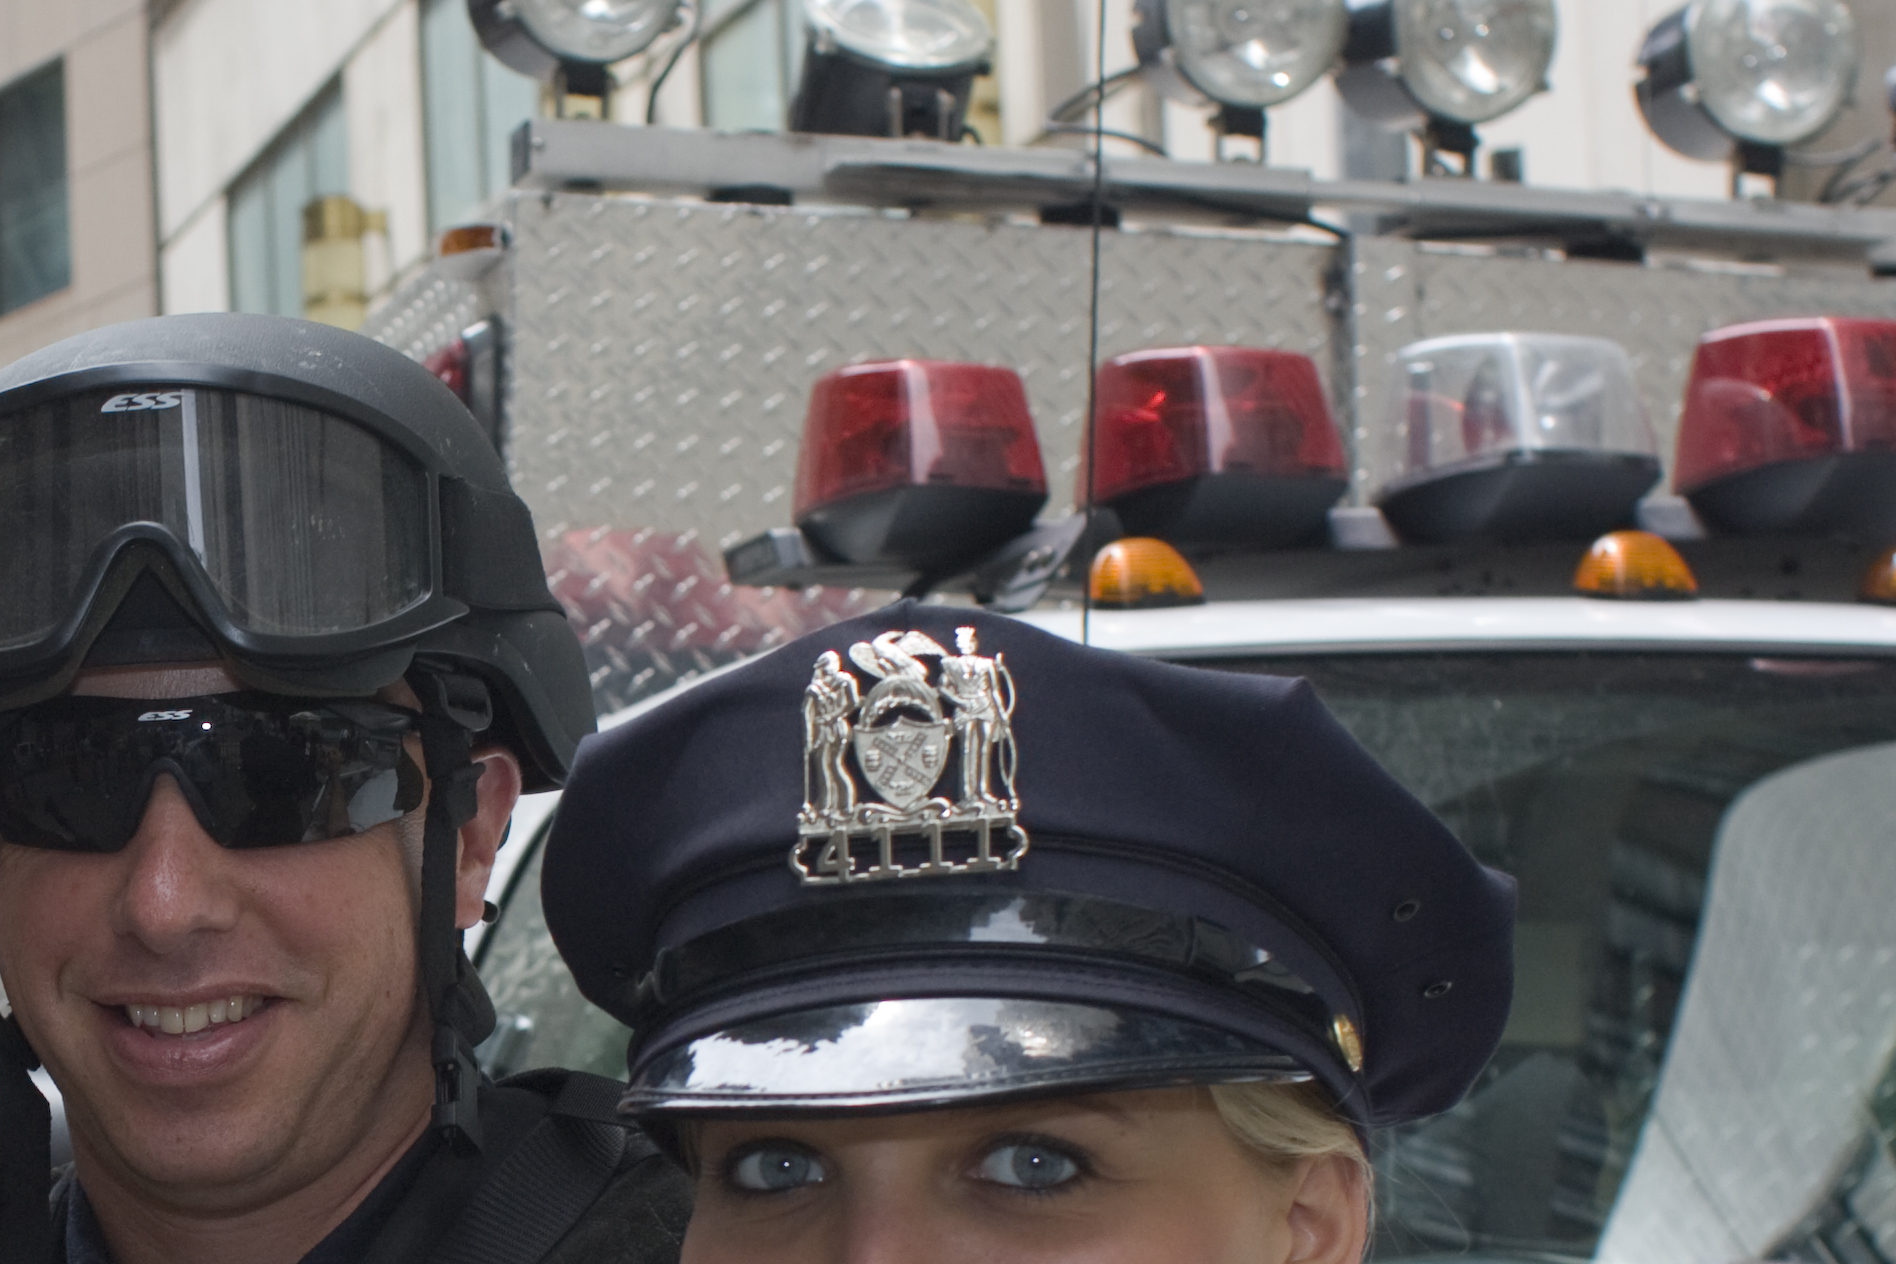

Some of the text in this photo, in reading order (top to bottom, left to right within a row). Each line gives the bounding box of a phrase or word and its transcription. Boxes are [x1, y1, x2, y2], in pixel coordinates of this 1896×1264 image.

[101, 392, 184, 413] ESS
[138, 709, 193, 721] ESS
[817, 815, 1002, 882] 4111
